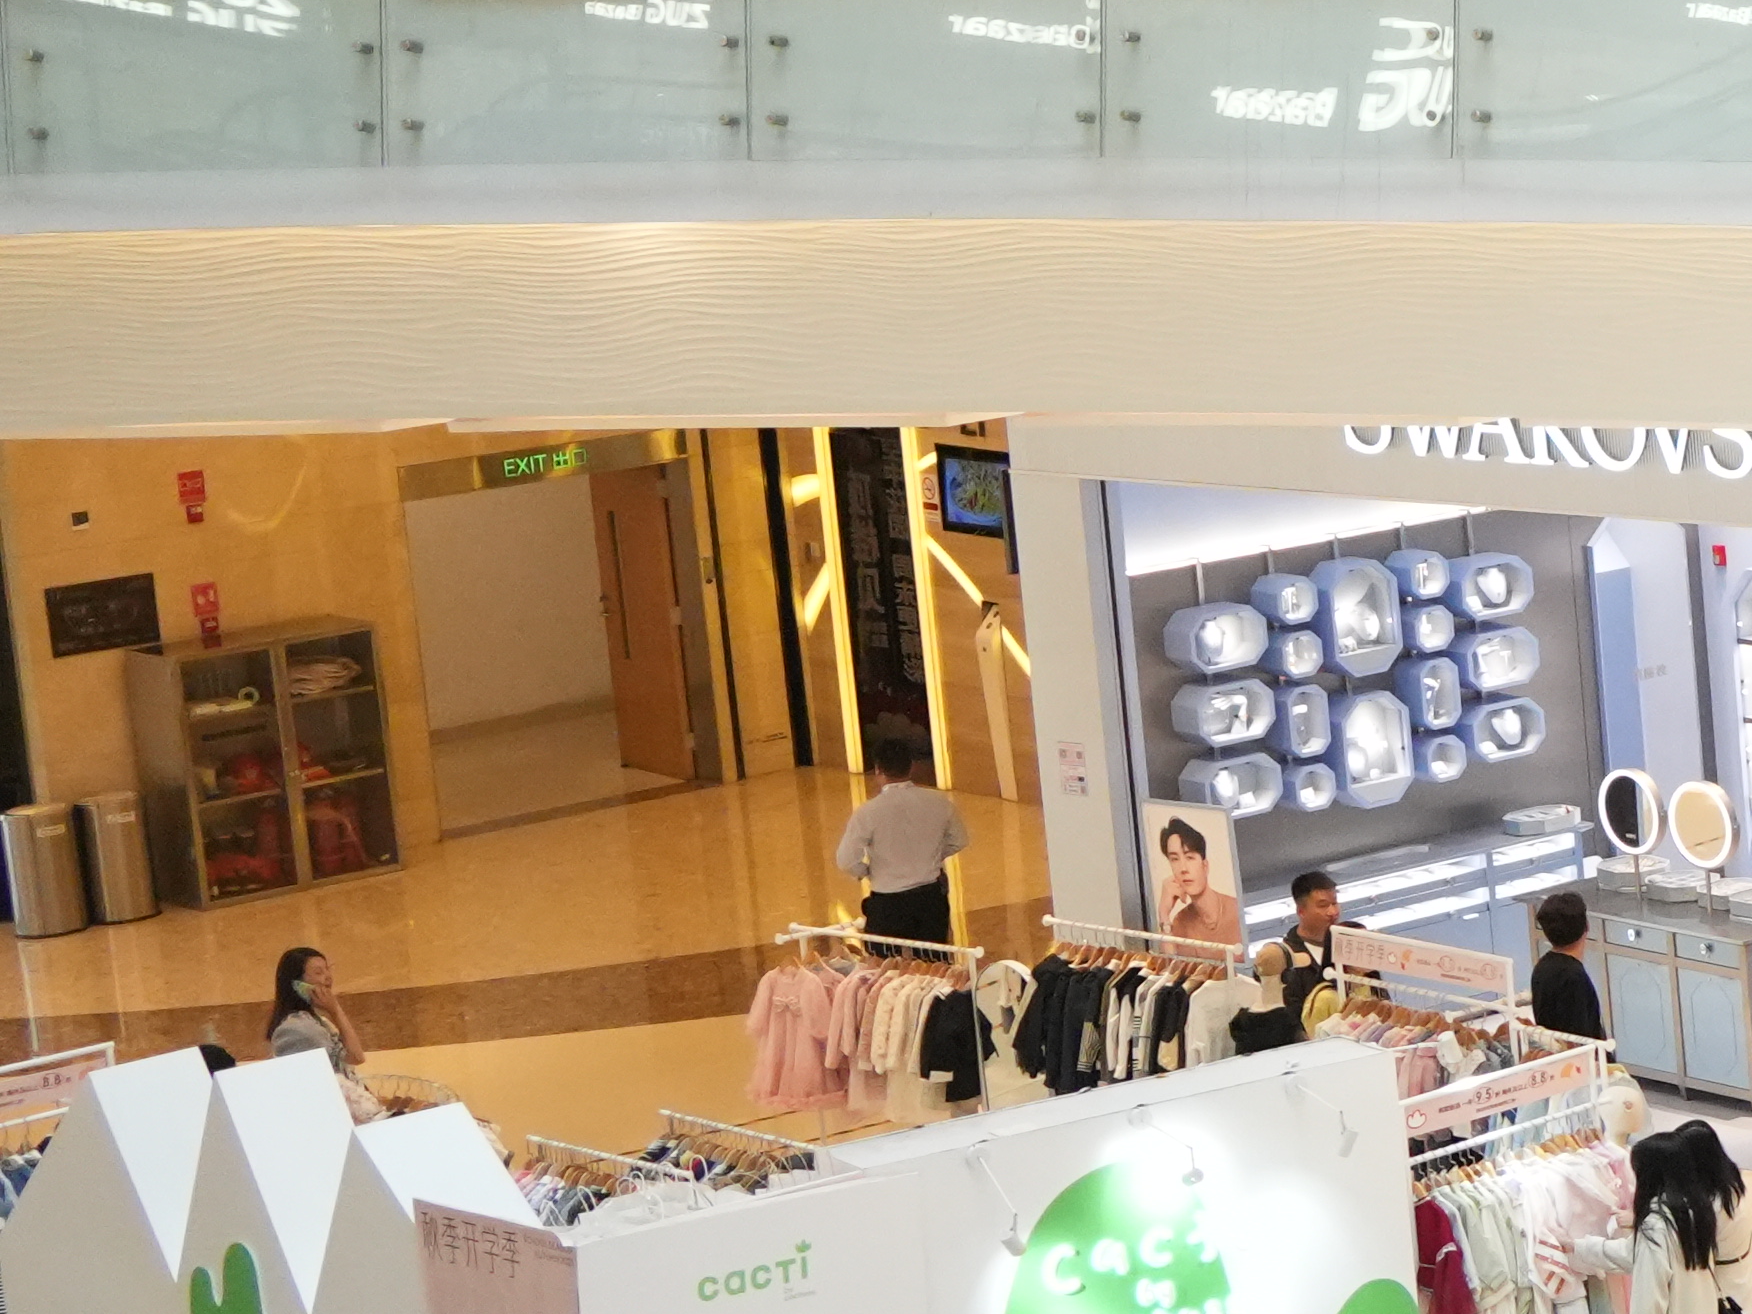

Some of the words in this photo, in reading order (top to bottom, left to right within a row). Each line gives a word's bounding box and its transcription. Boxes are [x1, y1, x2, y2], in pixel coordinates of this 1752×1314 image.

[503, 453, 547, 477] EXIT
[553, 448, 587, 468] 出口
[421, 1211, 520, 1278] 秋季开学季
